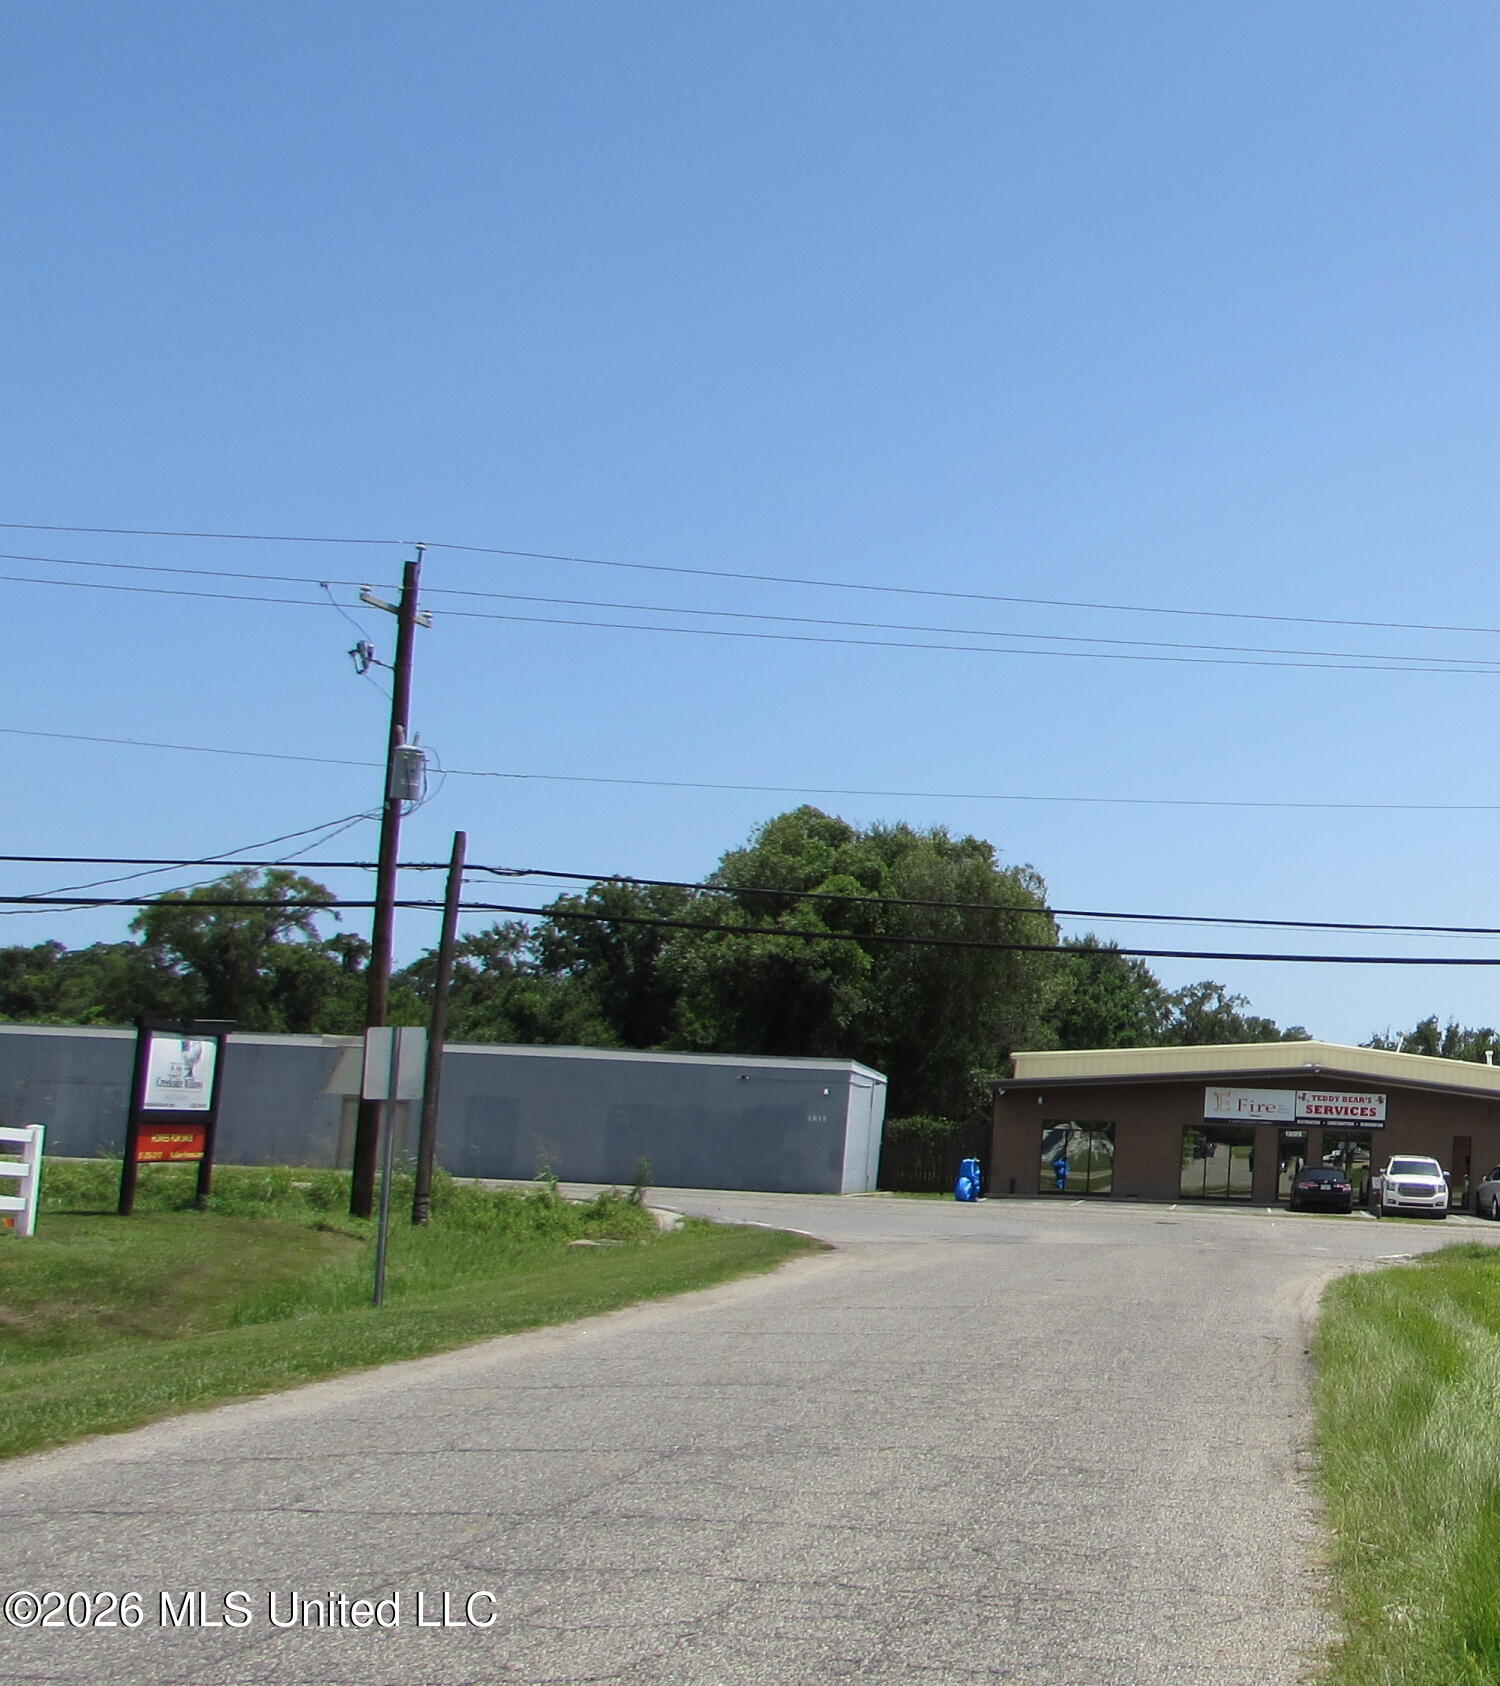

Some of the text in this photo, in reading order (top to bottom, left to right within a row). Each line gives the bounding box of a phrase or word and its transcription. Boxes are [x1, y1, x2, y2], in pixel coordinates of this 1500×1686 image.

[1237, 1098, 1276, 1113] Fire
[1342, 1096, 1372, 1104] BEAR'S
[1305, 1104, 1377, 1117] SERVICES
